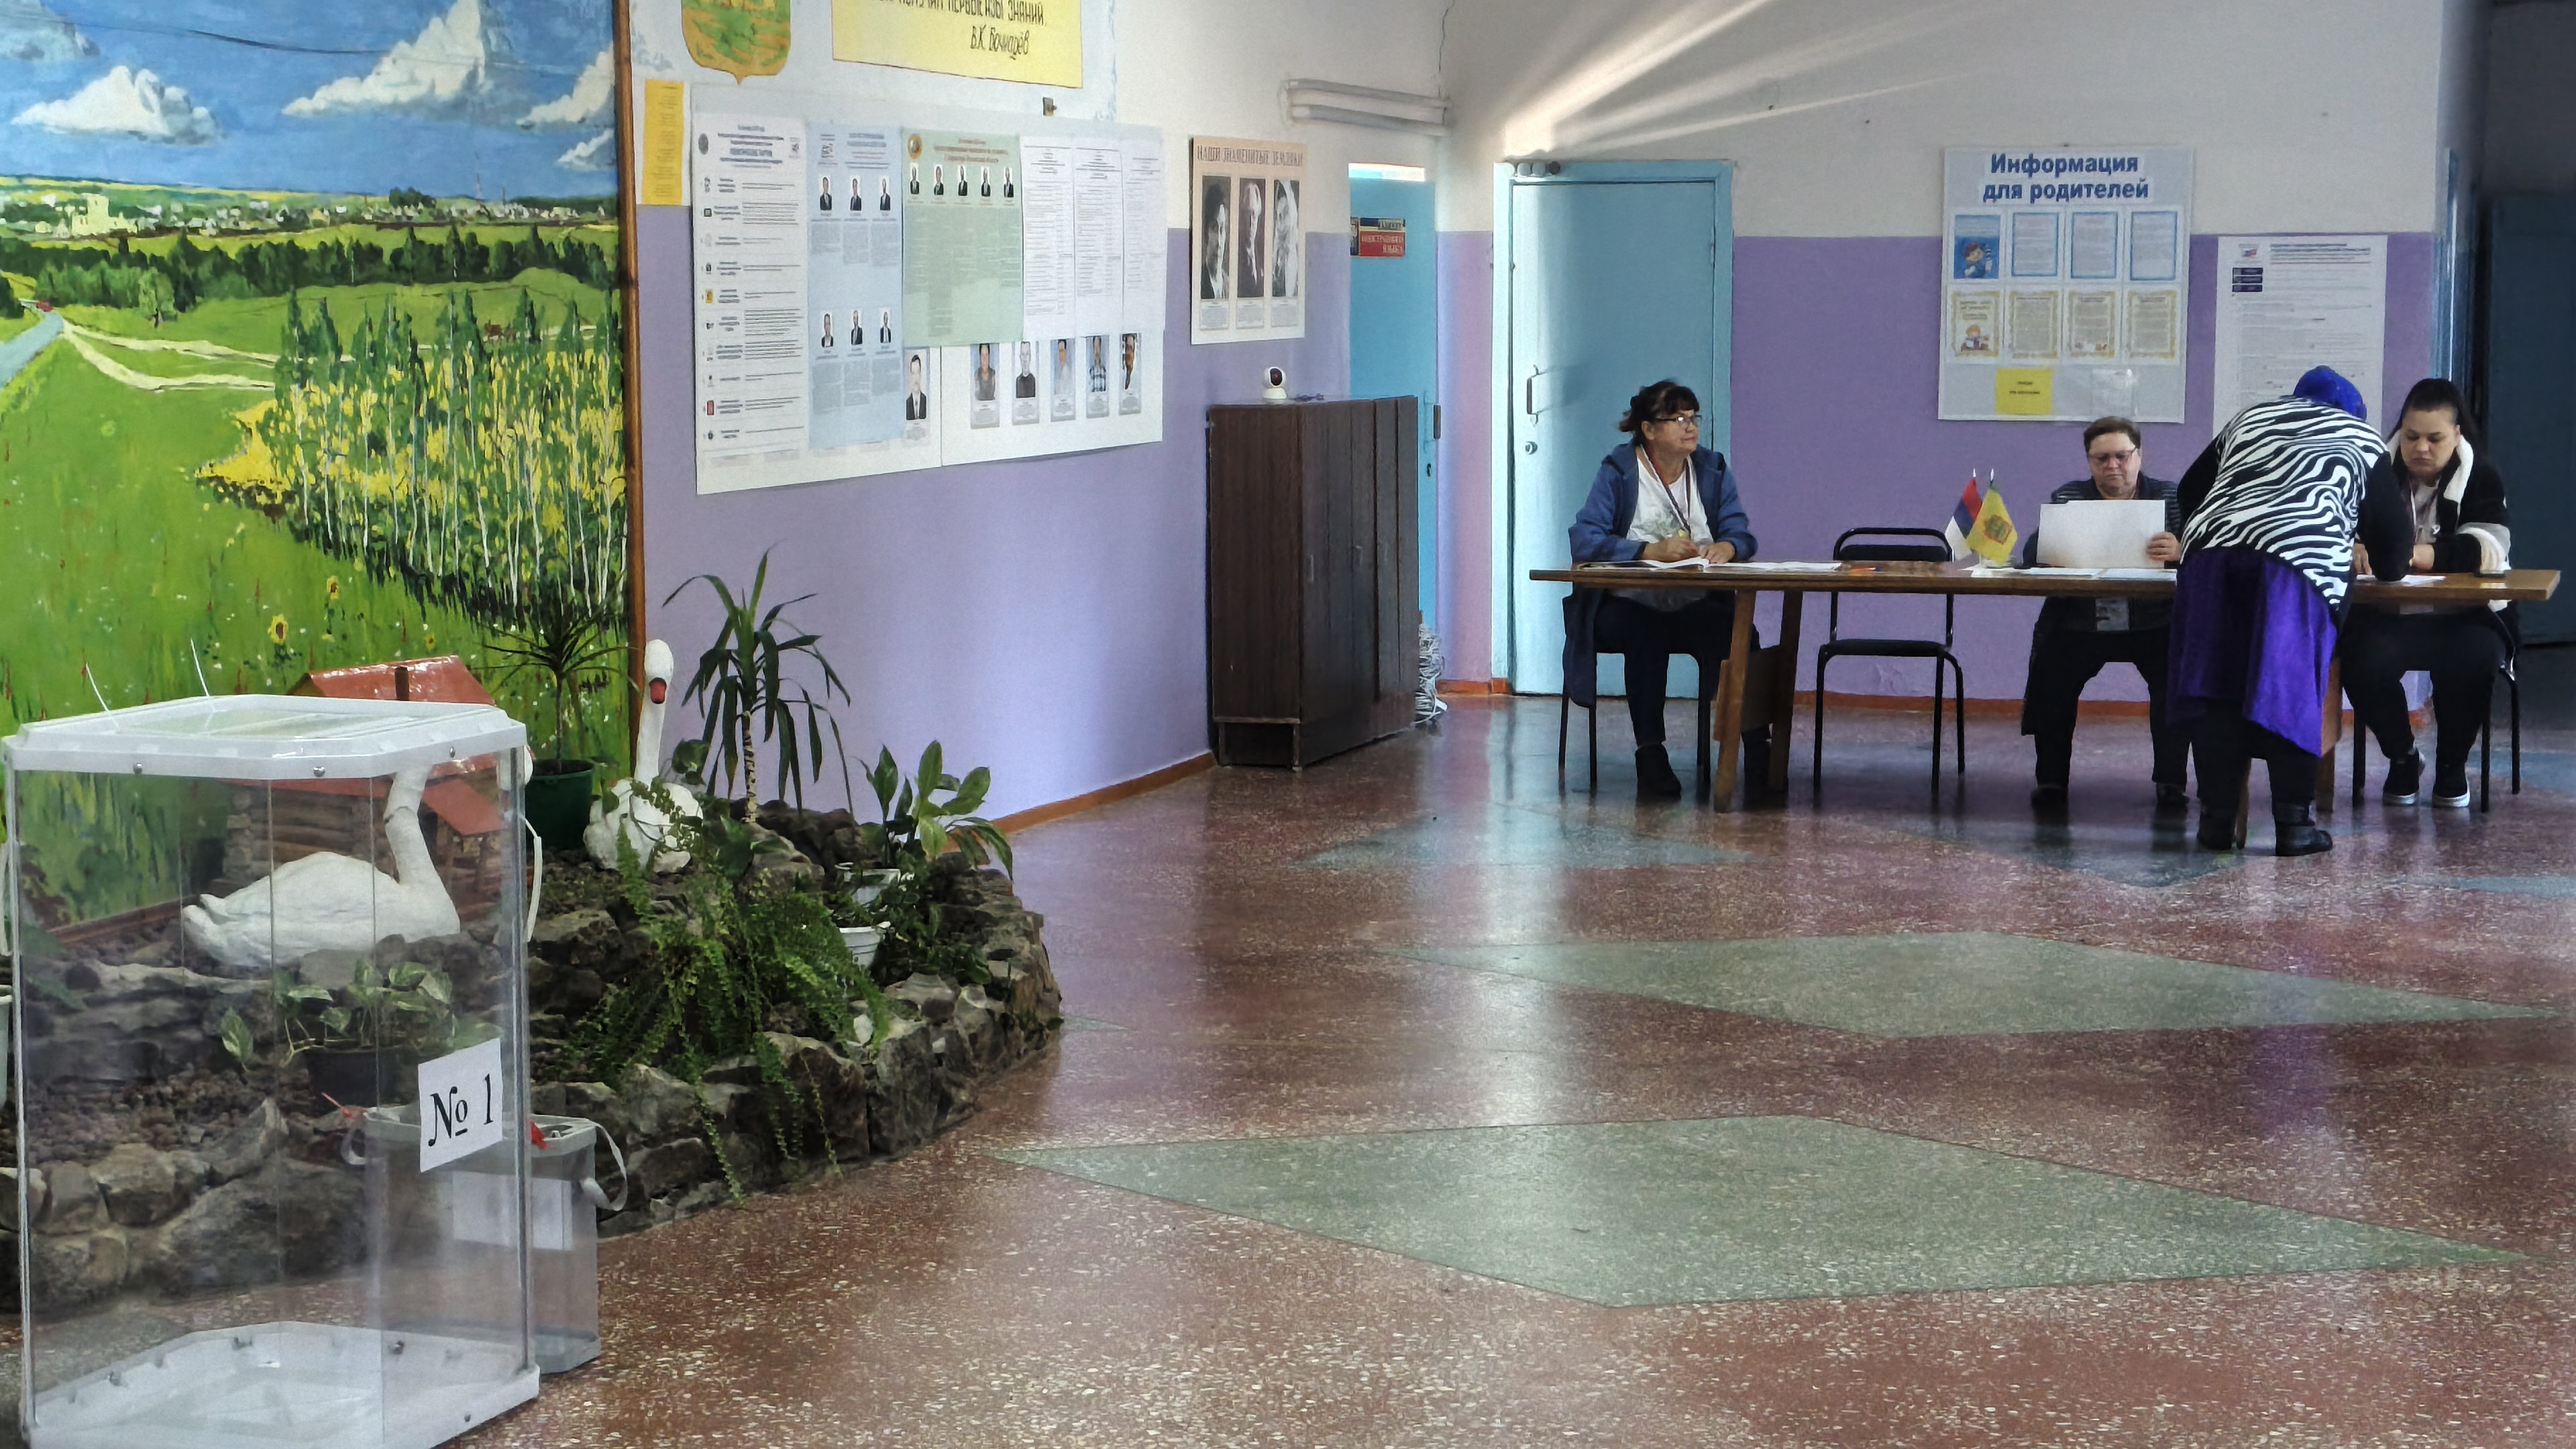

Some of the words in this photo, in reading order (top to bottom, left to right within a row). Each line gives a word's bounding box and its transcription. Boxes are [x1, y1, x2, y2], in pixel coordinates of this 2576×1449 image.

[1197, 146, 1220, 161] НАШИ
[1990, 153, 2139, 178] Информация
[1983, 184, 2023, 203] для
[2030, 178, 2149, 204] родителей
[428, 1086, 468, 1147] №
[483, 1073, 494, 1126] 1
